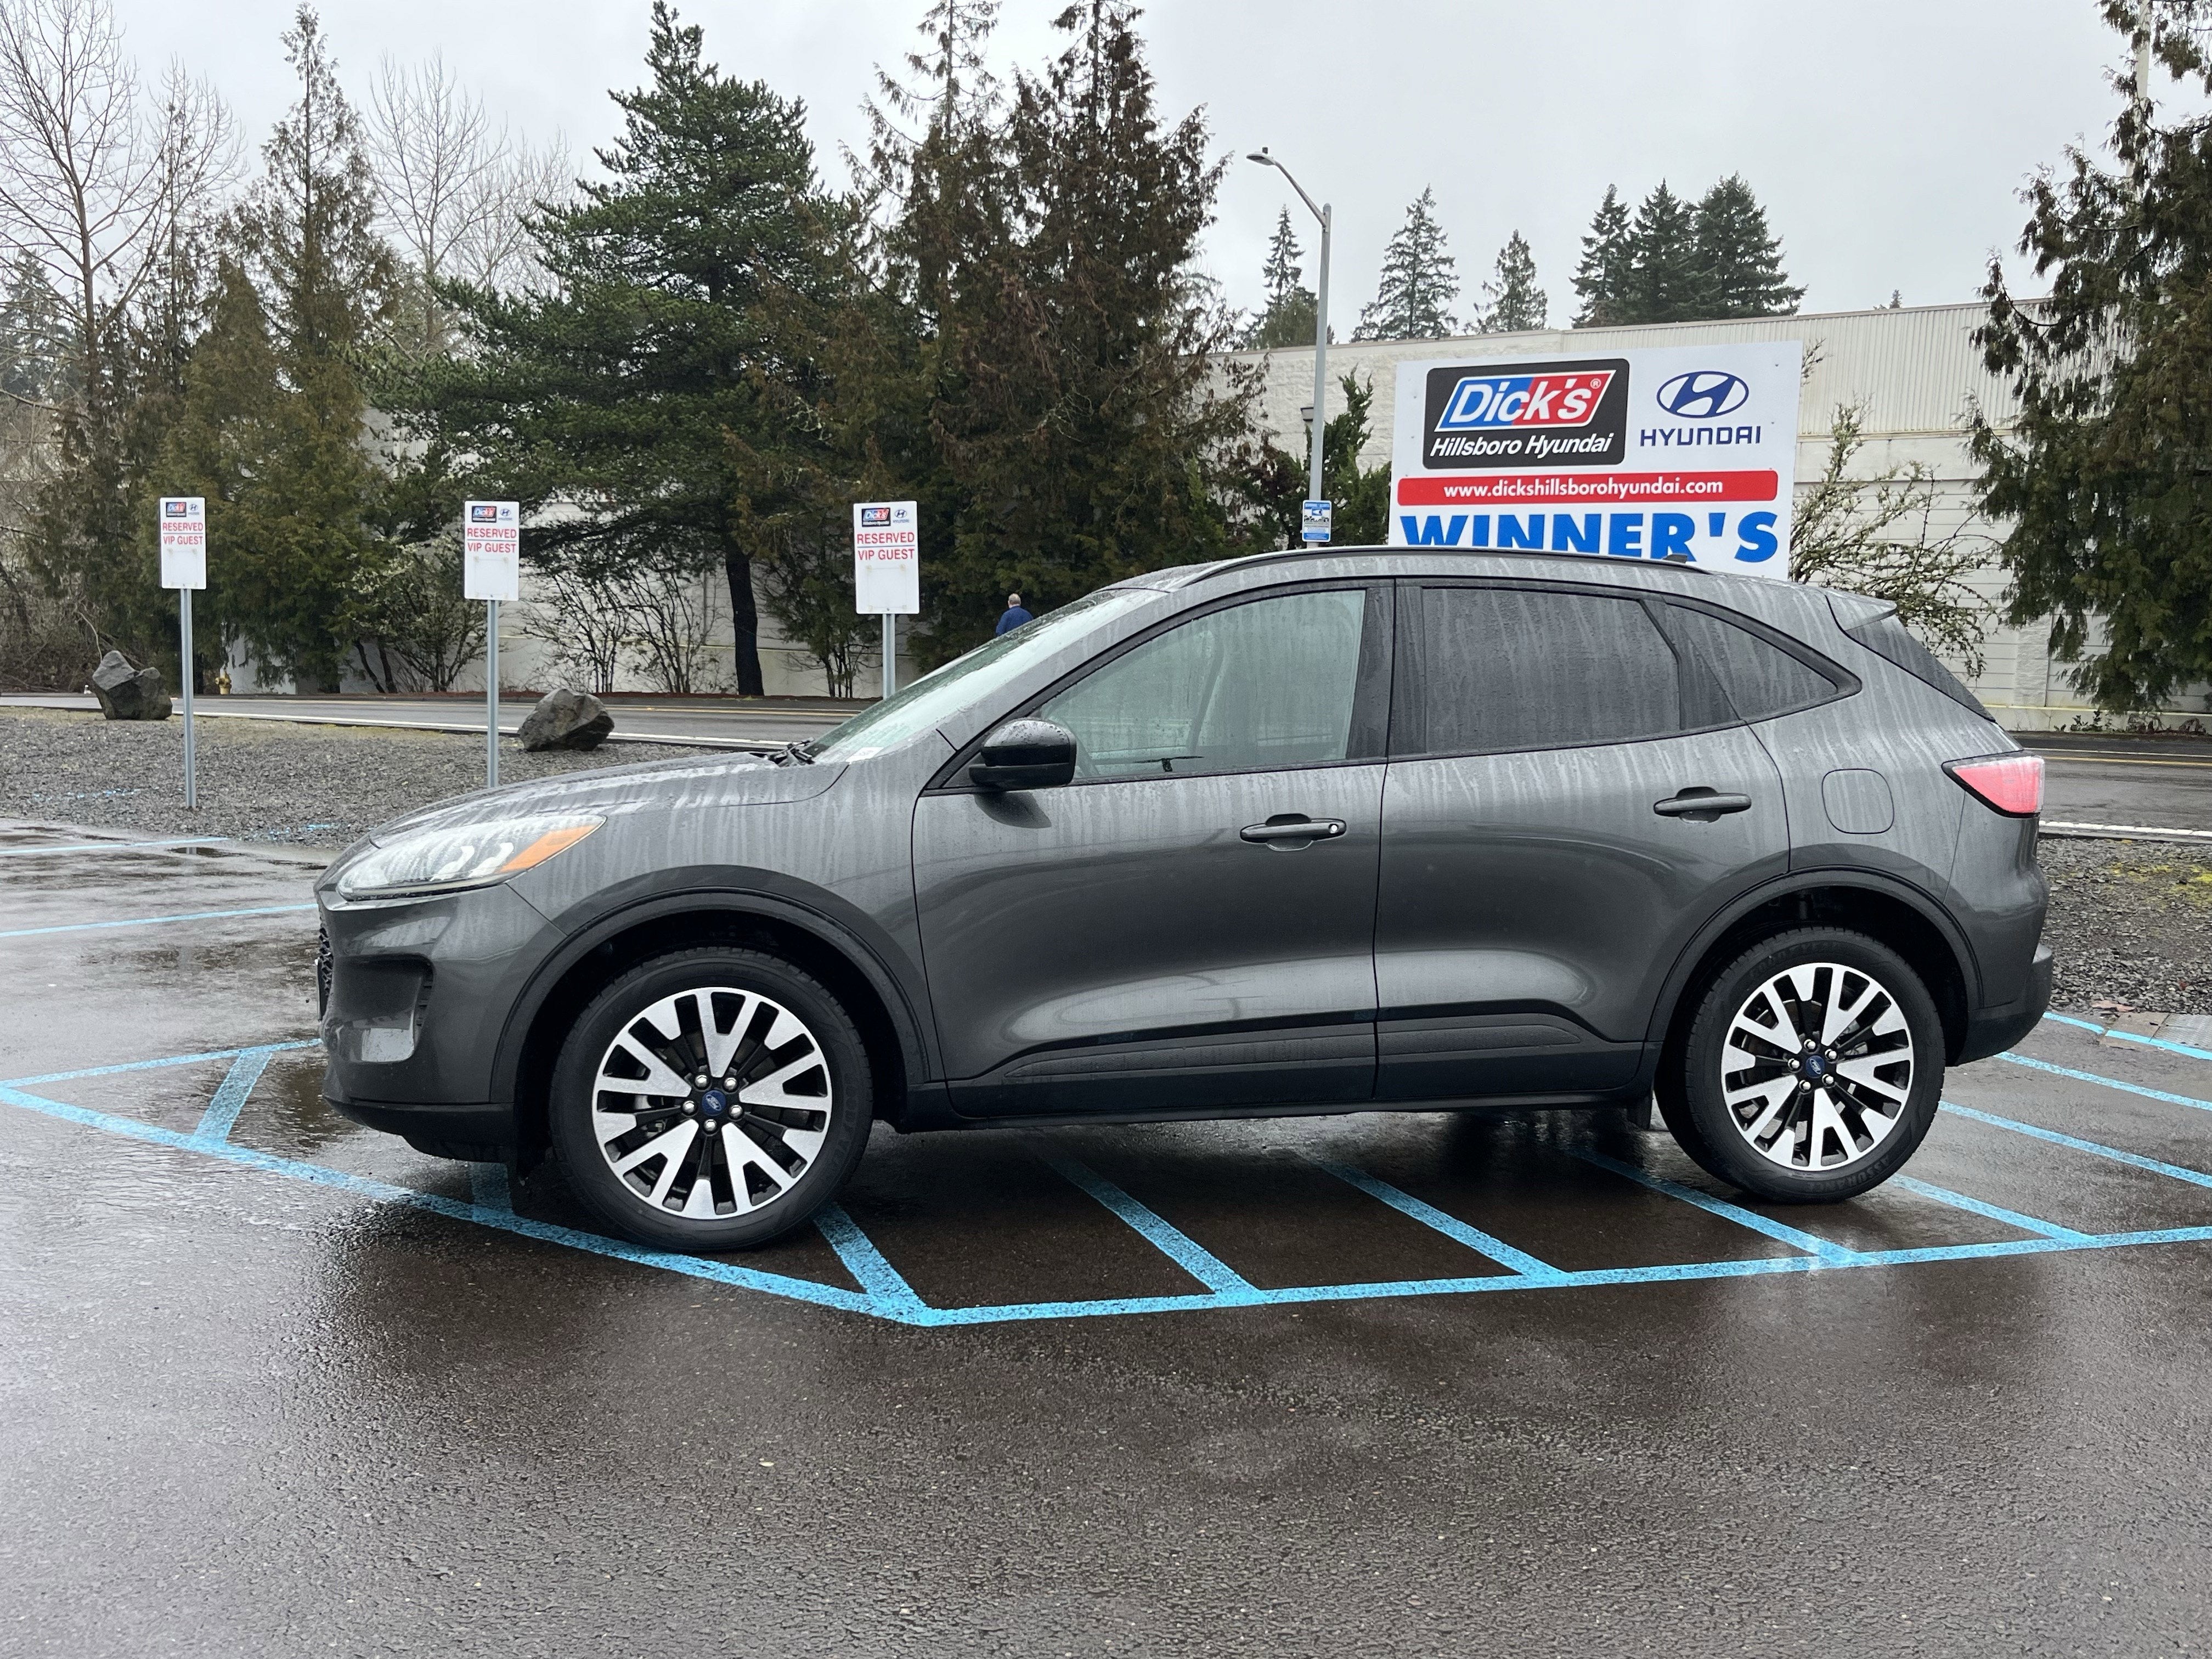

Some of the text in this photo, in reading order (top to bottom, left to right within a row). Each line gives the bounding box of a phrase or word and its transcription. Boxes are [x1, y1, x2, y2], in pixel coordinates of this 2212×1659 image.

[1449, 379, 1592, 423] Dick's
[1640, 426, 1761, 446] HYUNDAI
[1430, 433, 1615, 459] Hillsboro Hyundai
[1443, 476, 1723, 500] www.dickshillsborohyundai.com
[162, 522, 203, 531] RESERVED
[467, 528, 517, 538] RESERVED
[857, 532, 915, 544] RESERVED
[1400, 511, 1779, 562] WINNER'S
[163, 536, 203, 545] VIP GUEST
[467, 543, 516, 554] VIP GUEST
[858, 549, 915, 560] VIP GUEST
